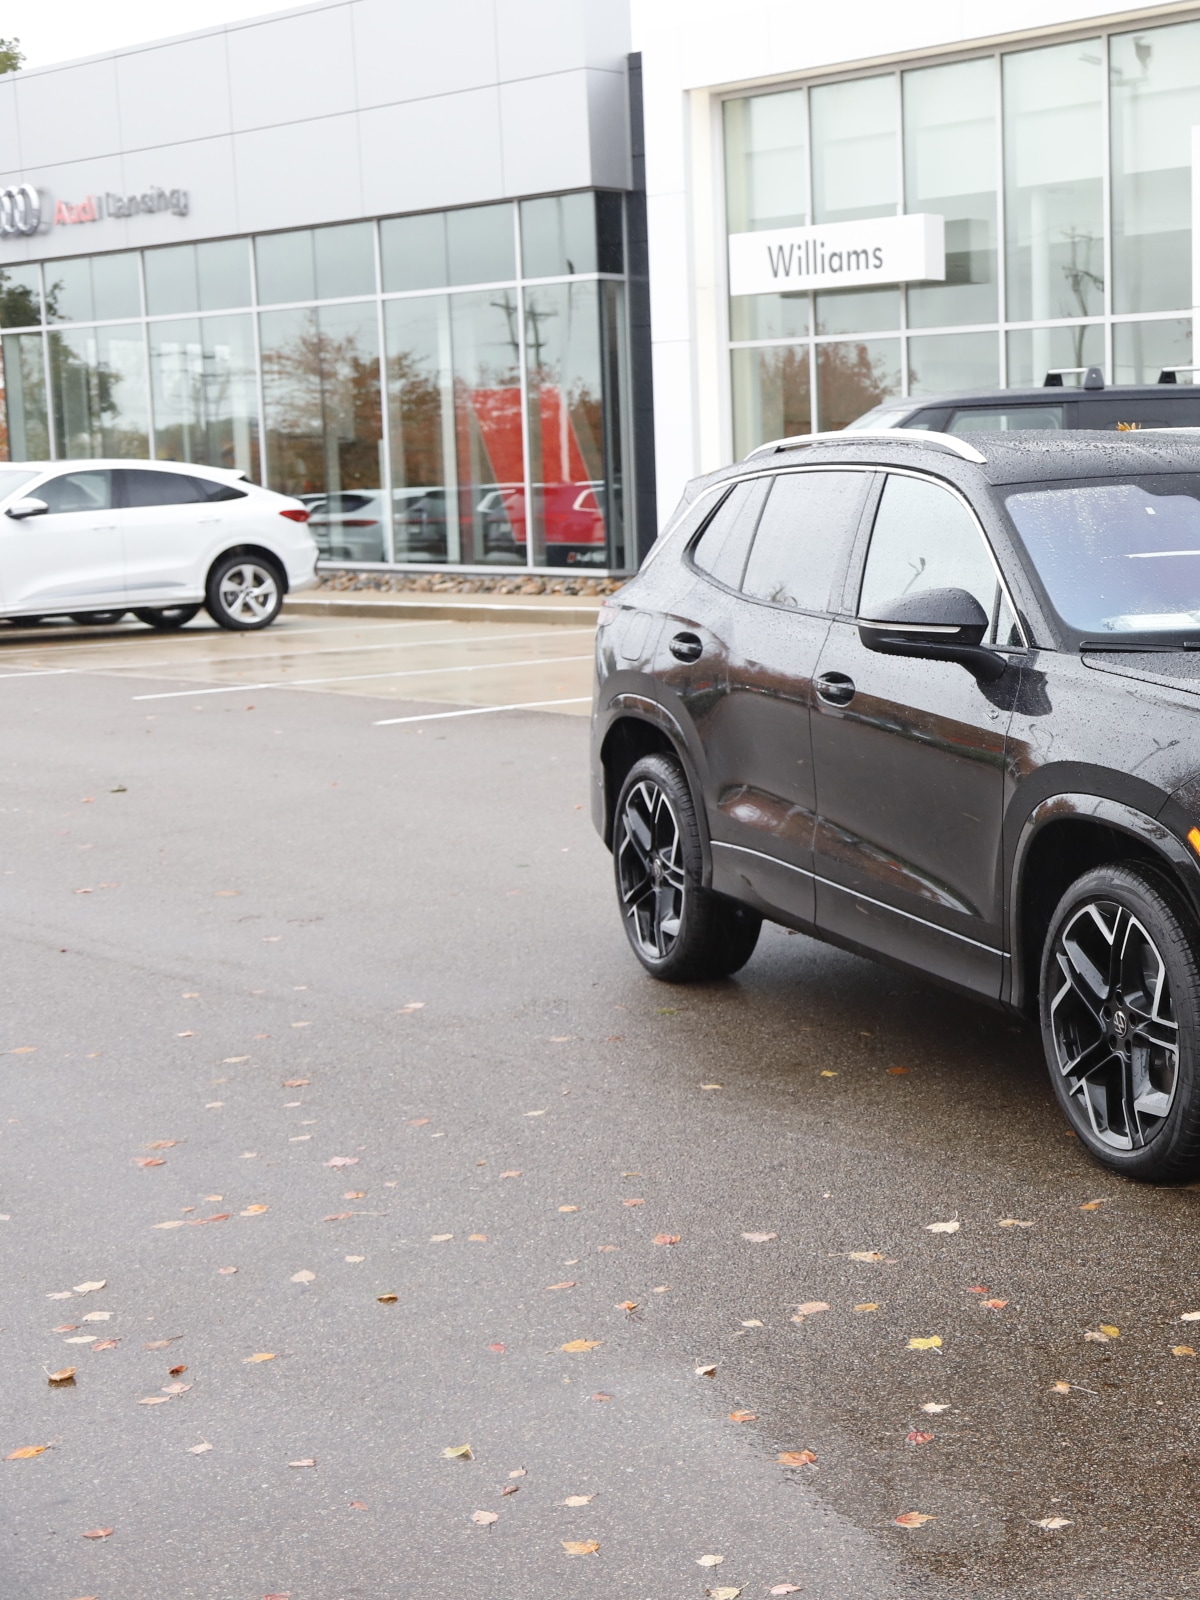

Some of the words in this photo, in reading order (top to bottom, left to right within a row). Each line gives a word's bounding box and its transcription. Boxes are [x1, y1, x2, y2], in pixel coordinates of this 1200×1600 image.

[54, 195, 97, 226] Audi
[106, 185, 190, 219] Lansing
[767, 239, 883, 278] Williams
